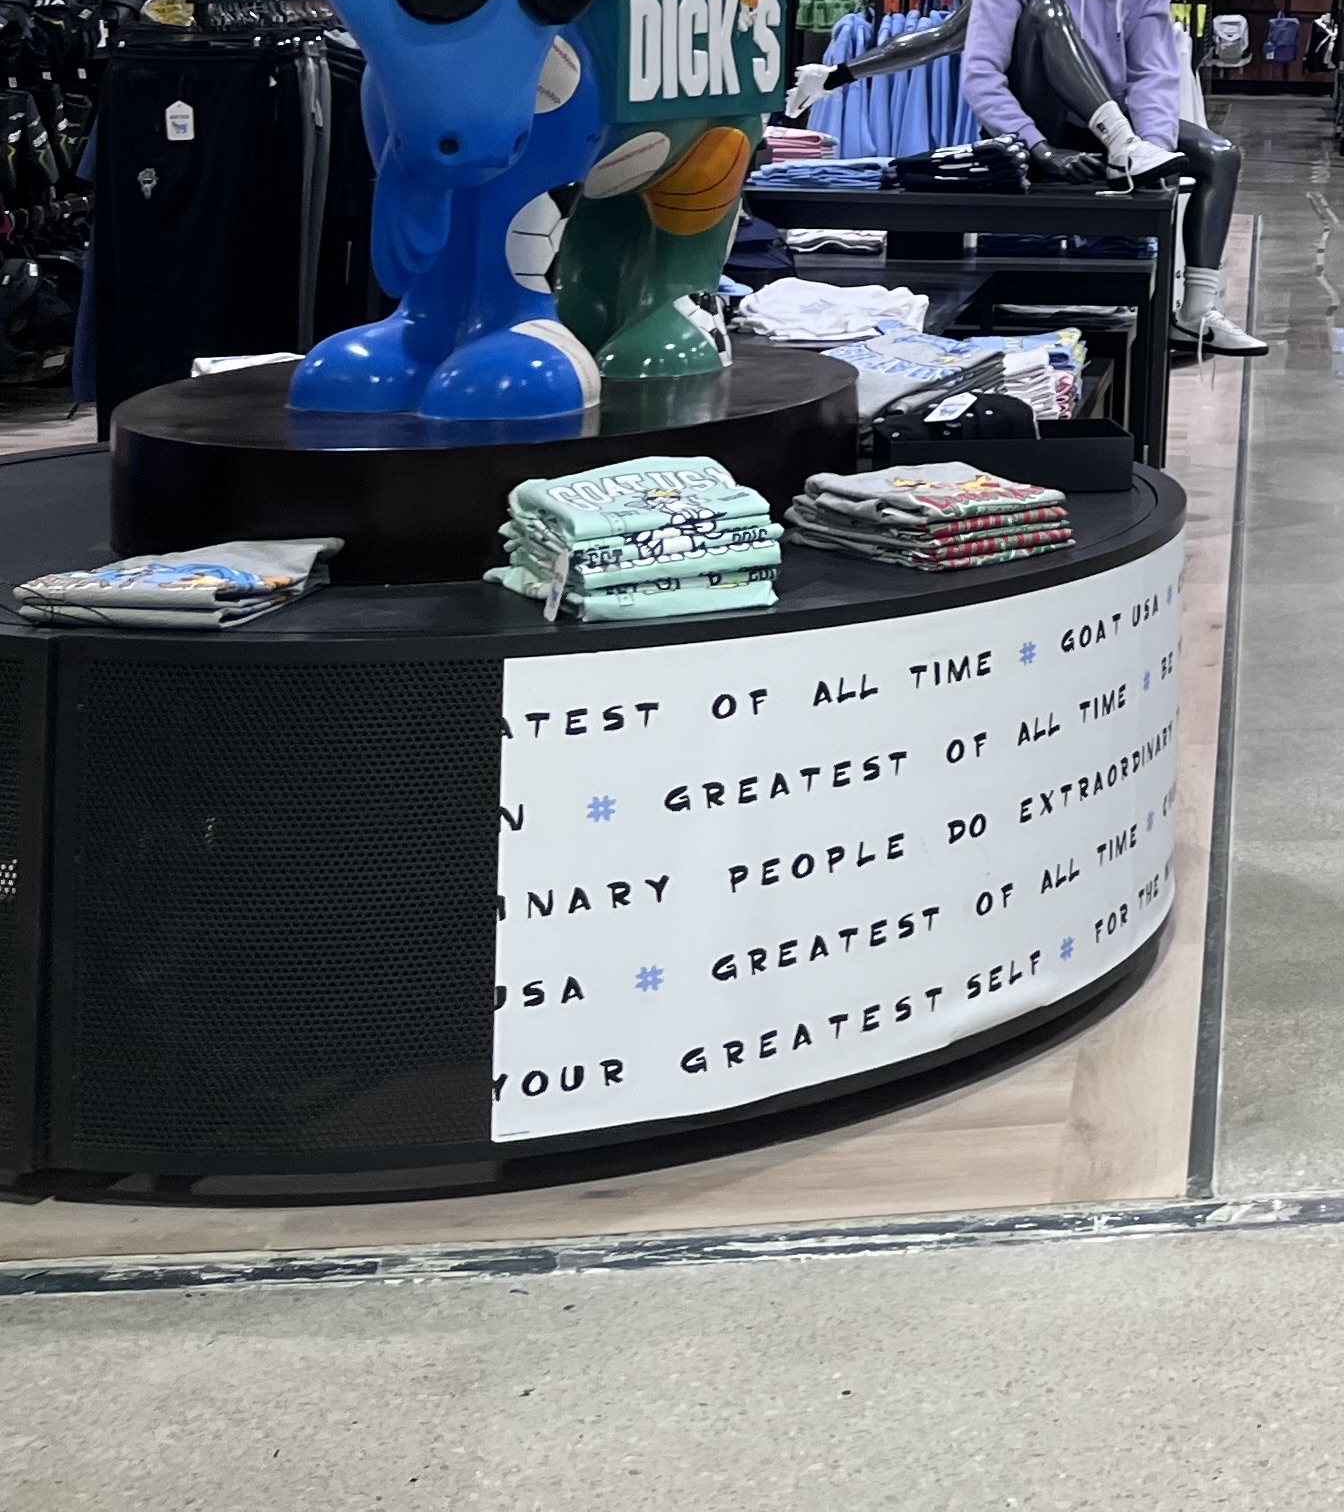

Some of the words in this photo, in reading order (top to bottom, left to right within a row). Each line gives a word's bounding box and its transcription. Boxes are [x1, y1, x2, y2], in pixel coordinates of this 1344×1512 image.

[546, 471, 646, 512] GOAT
[711, 688, 768, 720] OF
[812, 673, 879, 707] ALL
[910, 650, 992, 689] TIME
[1060, 612, 1122, 655] GOAT
[1132, 594, 1159, 628] USA
[664, 749, 908, 812] GREATEST
[946, 731, 987, 764] OF
[1017, 712, 1061, 747] ALL
[1079, 684, 1127, 723] TIME
[728, 832, 905, 893] PEOPLE
[947, 813, 987, 845] DO
[1019, 719, 1174, 824] EXTRAORDINARY
[711, 906, 941, 981] GREATEST
[975, 882, 1014, 916] OF
[1040, 858, 1080, 894] ALL
[1096, 823, 1138, 856] TIME
[493, 1058, 625, 1102] YOUR
[680, 987, 943, 1074] GREATEST
[967, 949, 1041, 1000] SELF
[1094, 903, 1128, 944] FOR
[1138, 873, 1160, 911] THE
